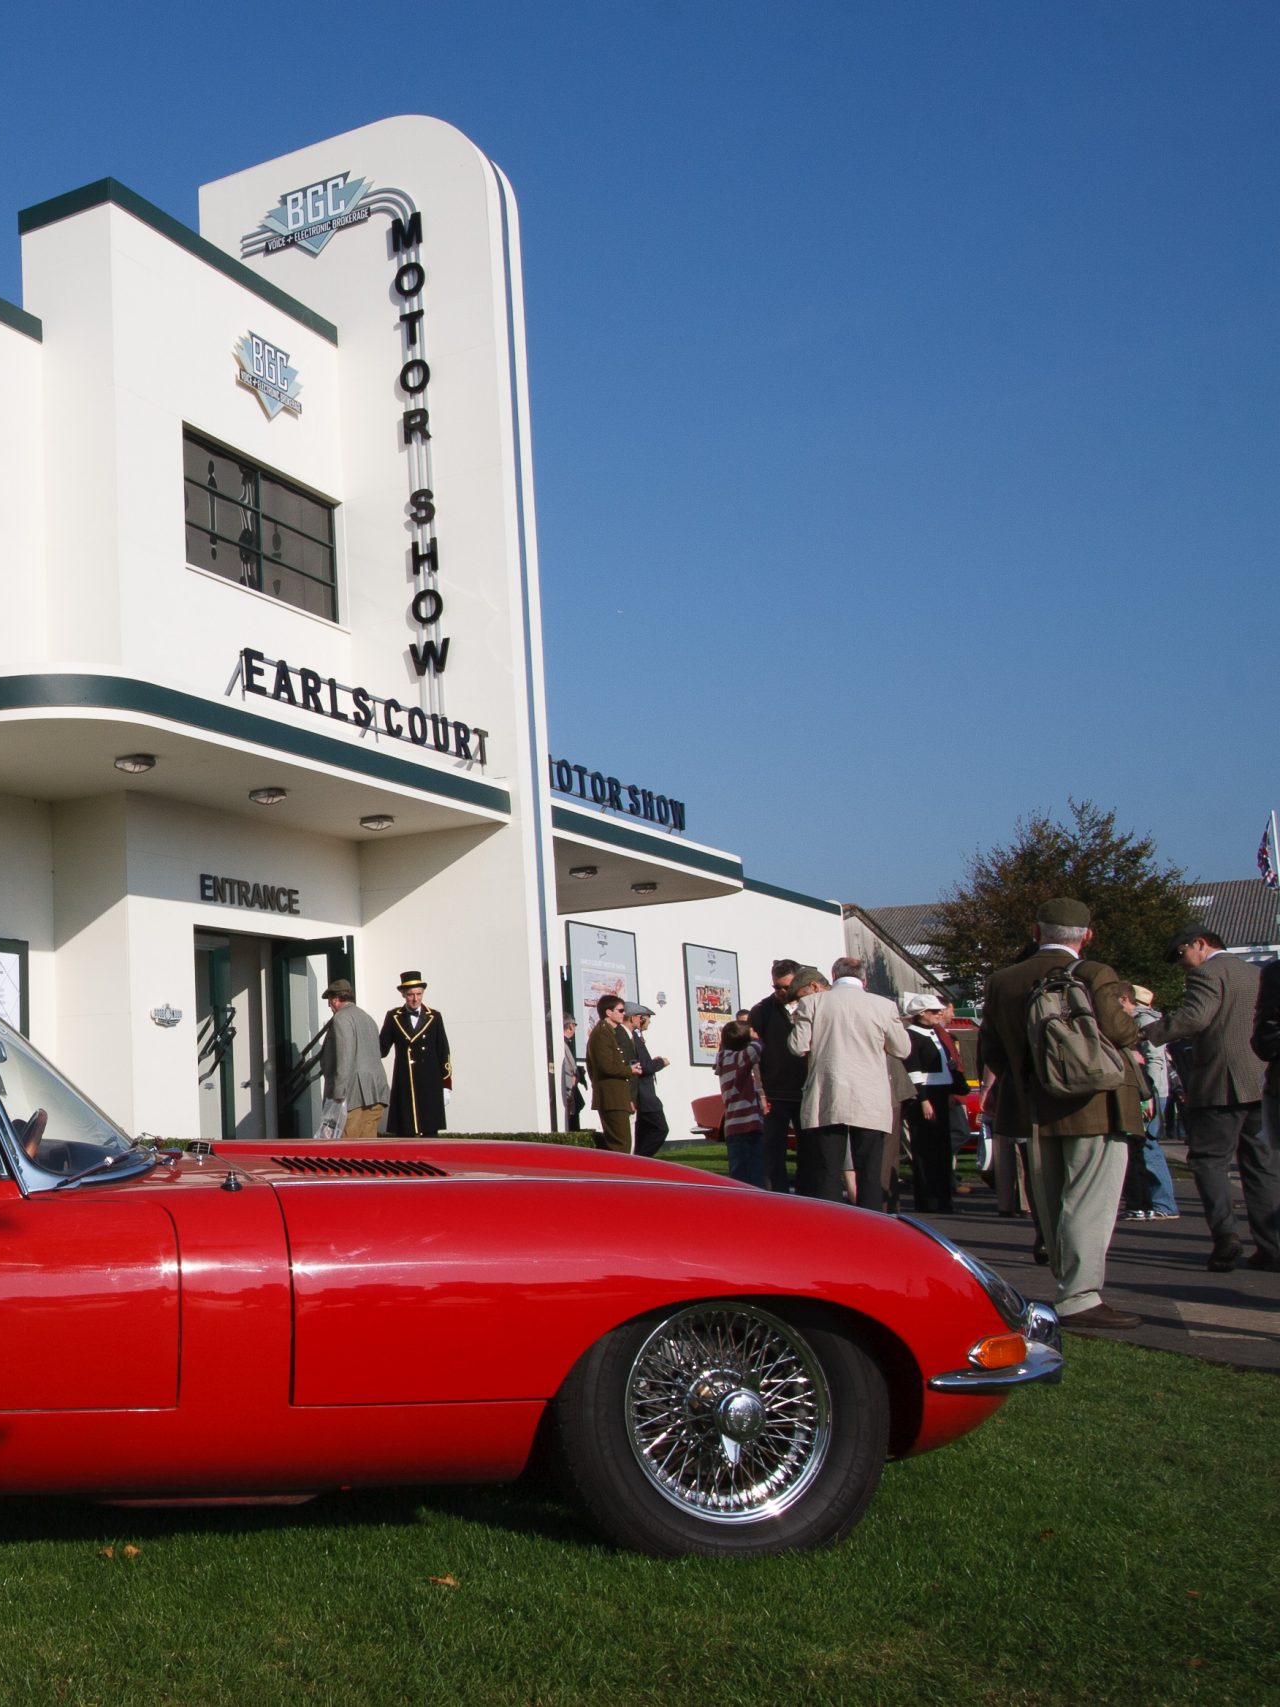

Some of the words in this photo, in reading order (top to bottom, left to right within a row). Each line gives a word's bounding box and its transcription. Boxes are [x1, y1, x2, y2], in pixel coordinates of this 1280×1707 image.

[268, 236, 285, 251] VOICE
[294, 223, 331, 242] ELECTRONIC
[332, 208, 369, 229] BROKERAGE
[287, 177, 345, 231] BGC
[392, 211, 431, 444] MOTOR
[252, 336, 288, 392] BGC
[409, 489, 450, 676] SHOW
[243, 647, 371, 727] EARLS
[384, 698, 489, 765] COURT
[548, 754, 623, 811] OTOR
[628, 784, 686, 830] SHOW
[200, 873, 300, 914] ENTRANCE
